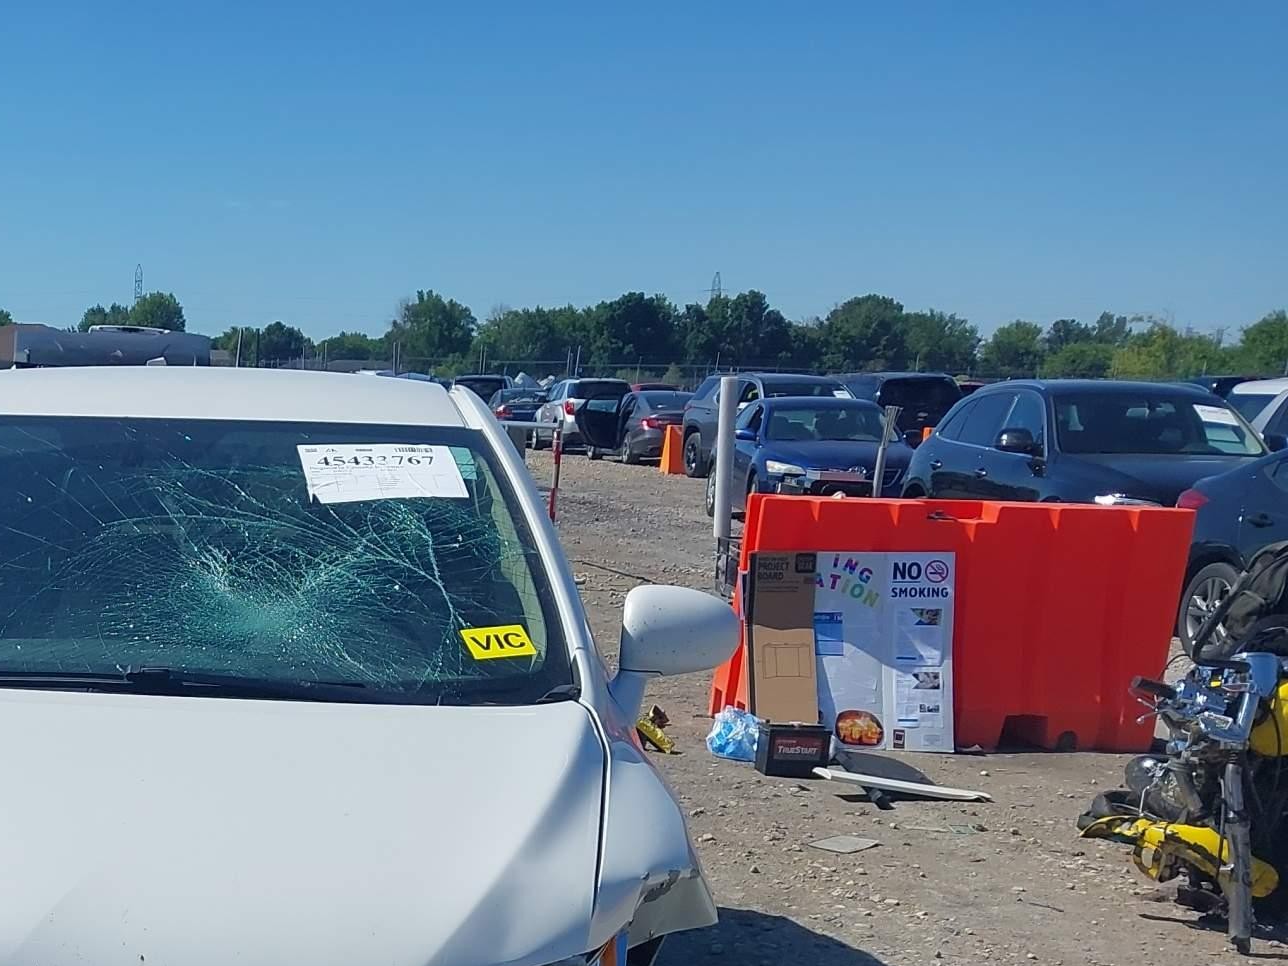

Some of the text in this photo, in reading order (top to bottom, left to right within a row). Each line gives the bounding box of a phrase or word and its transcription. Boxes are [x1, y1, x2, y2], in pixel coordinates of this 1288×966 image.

[317, 455, 434, 466] 45433767
[893, 562, 922, 580] NO
[891, 587, 949, 598] SMOKING
[470, 632, 526, 650] VIC
